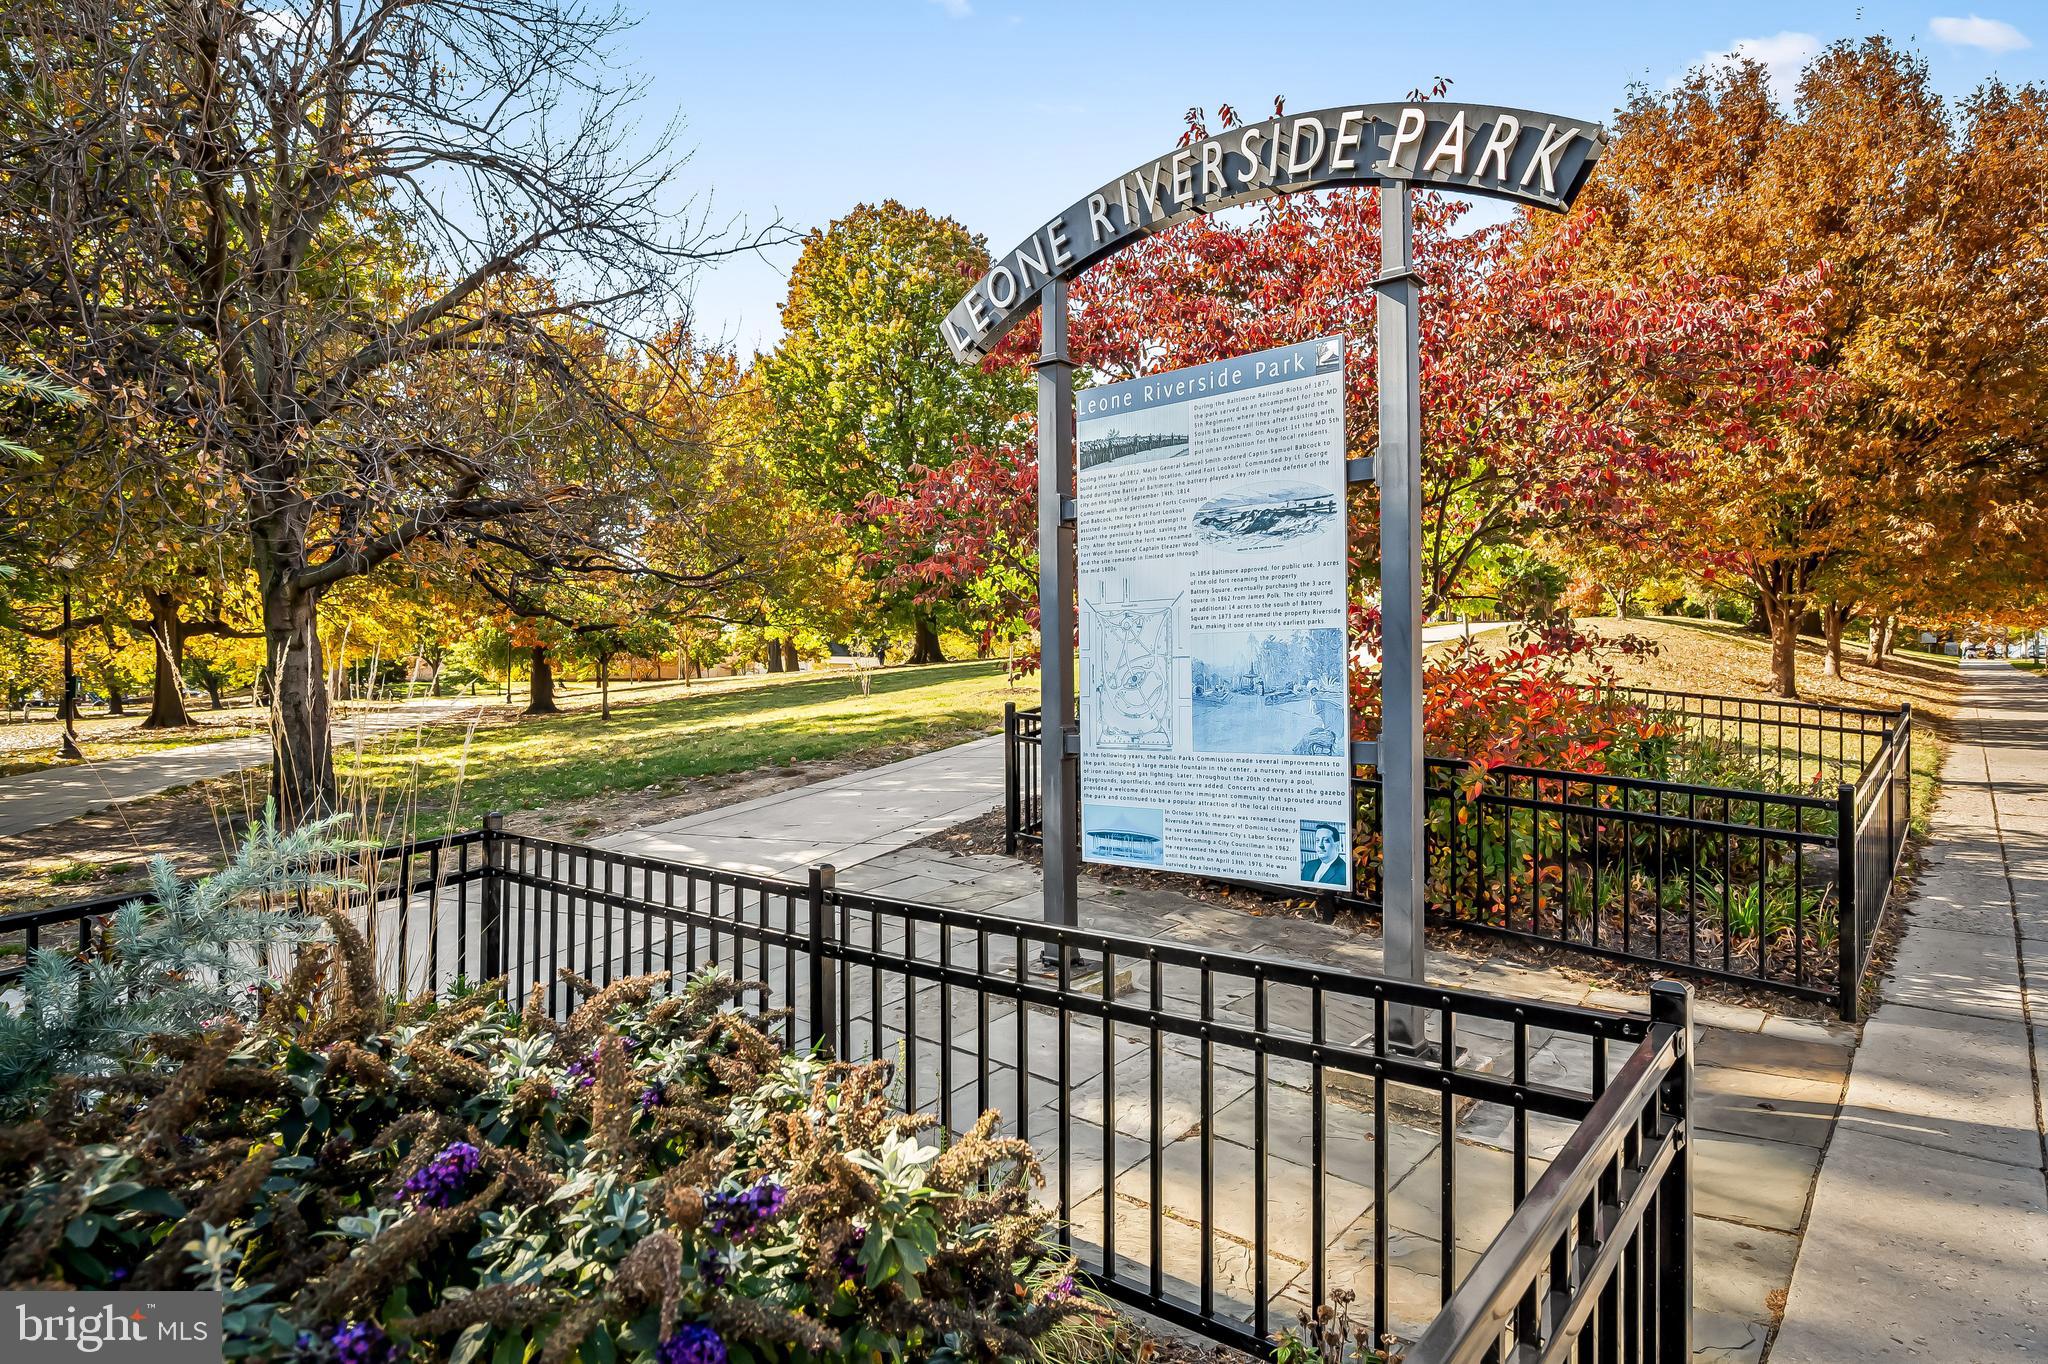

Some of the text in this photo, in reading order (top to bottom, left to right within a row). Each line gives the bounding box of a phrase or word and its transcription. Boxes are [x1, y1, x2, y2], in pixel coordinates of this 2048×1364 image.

[949, 107, 1581, 352] LEONE RIVERSIDE PARK
[1078, 352, 1305, 416] Leone Riverside Park
